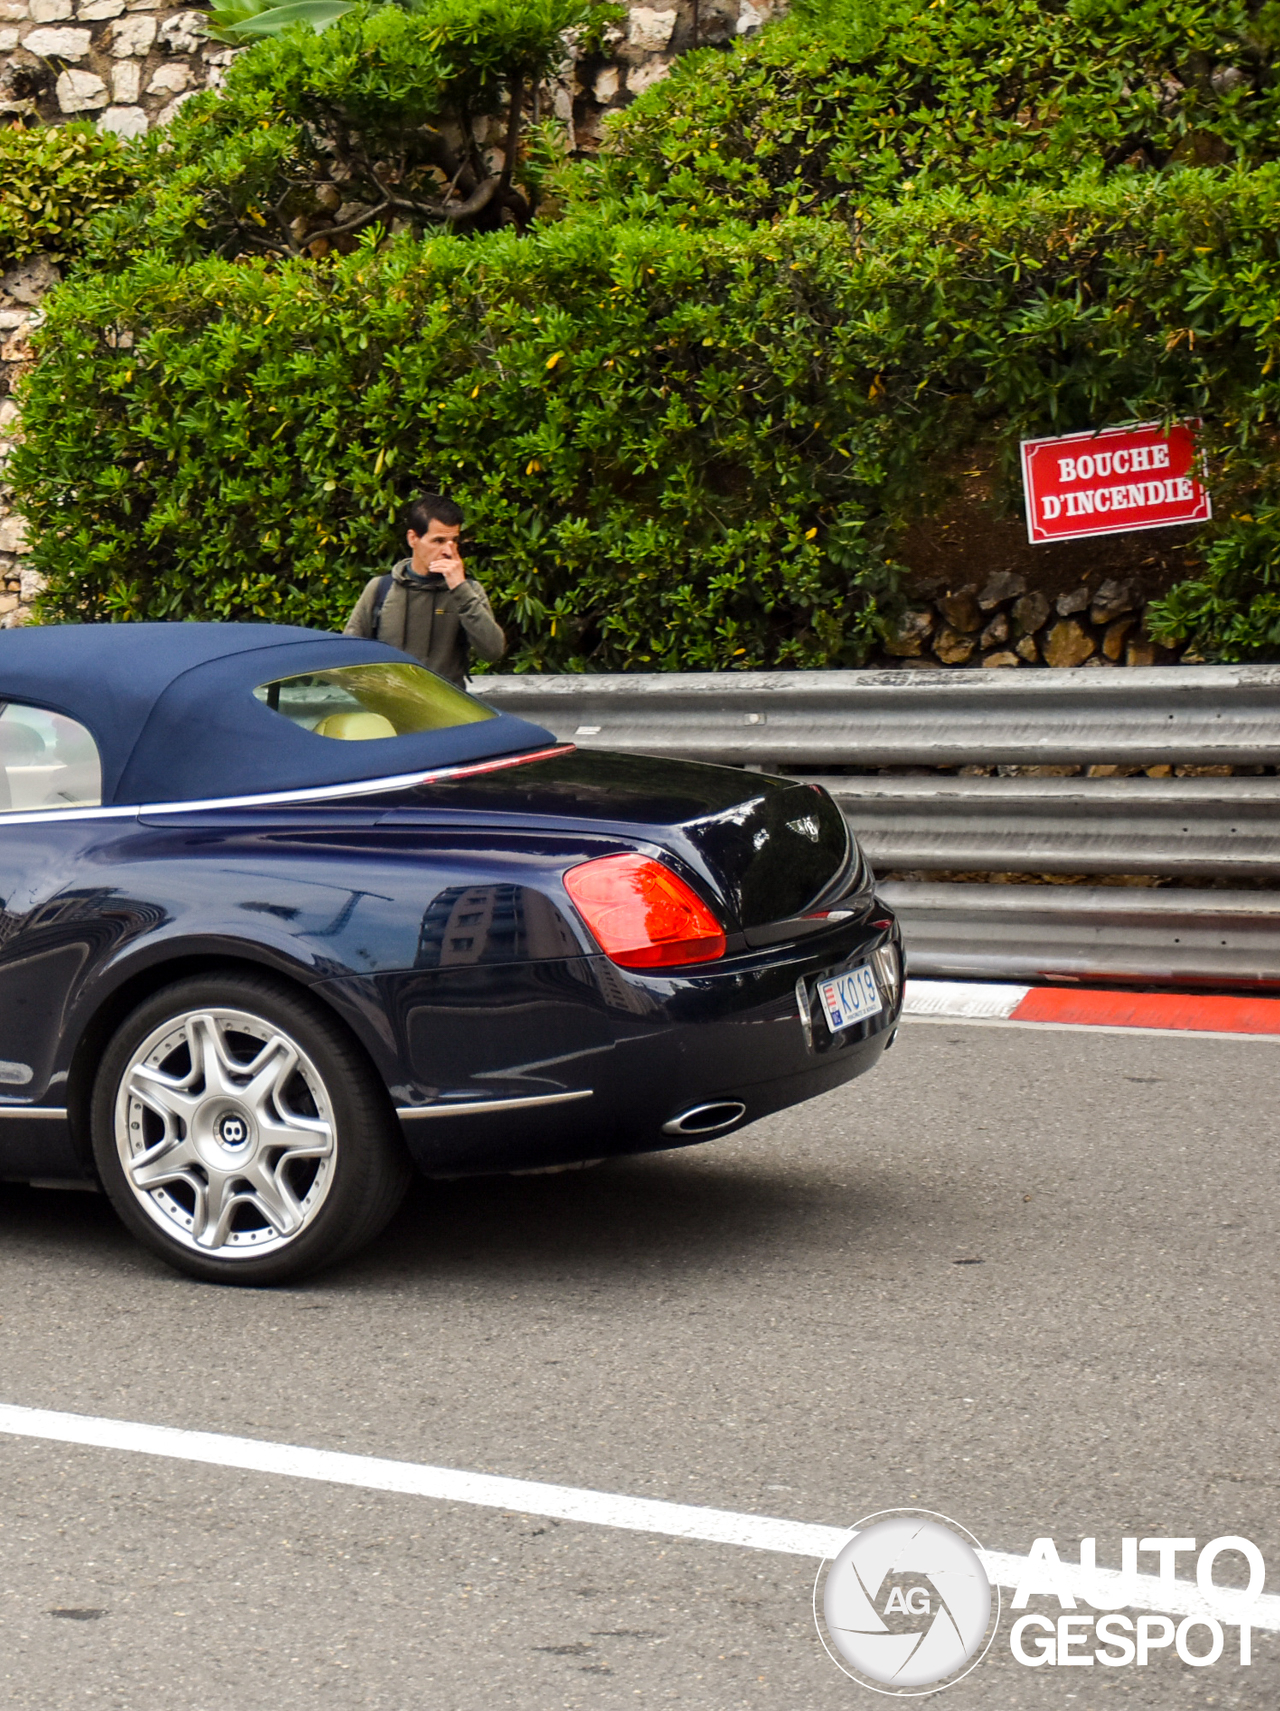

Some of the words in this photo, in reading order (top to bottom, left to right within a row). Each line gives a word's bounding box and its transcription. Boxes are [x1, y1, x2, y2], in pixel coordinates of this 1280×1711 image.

[1057, 444, 1170, 482] BOUCHE
[1041, 477, 1194, 520] D'INCENDIE
[837, 970, 876, 1014] K019
[223, 1121, 243, 1142] B
